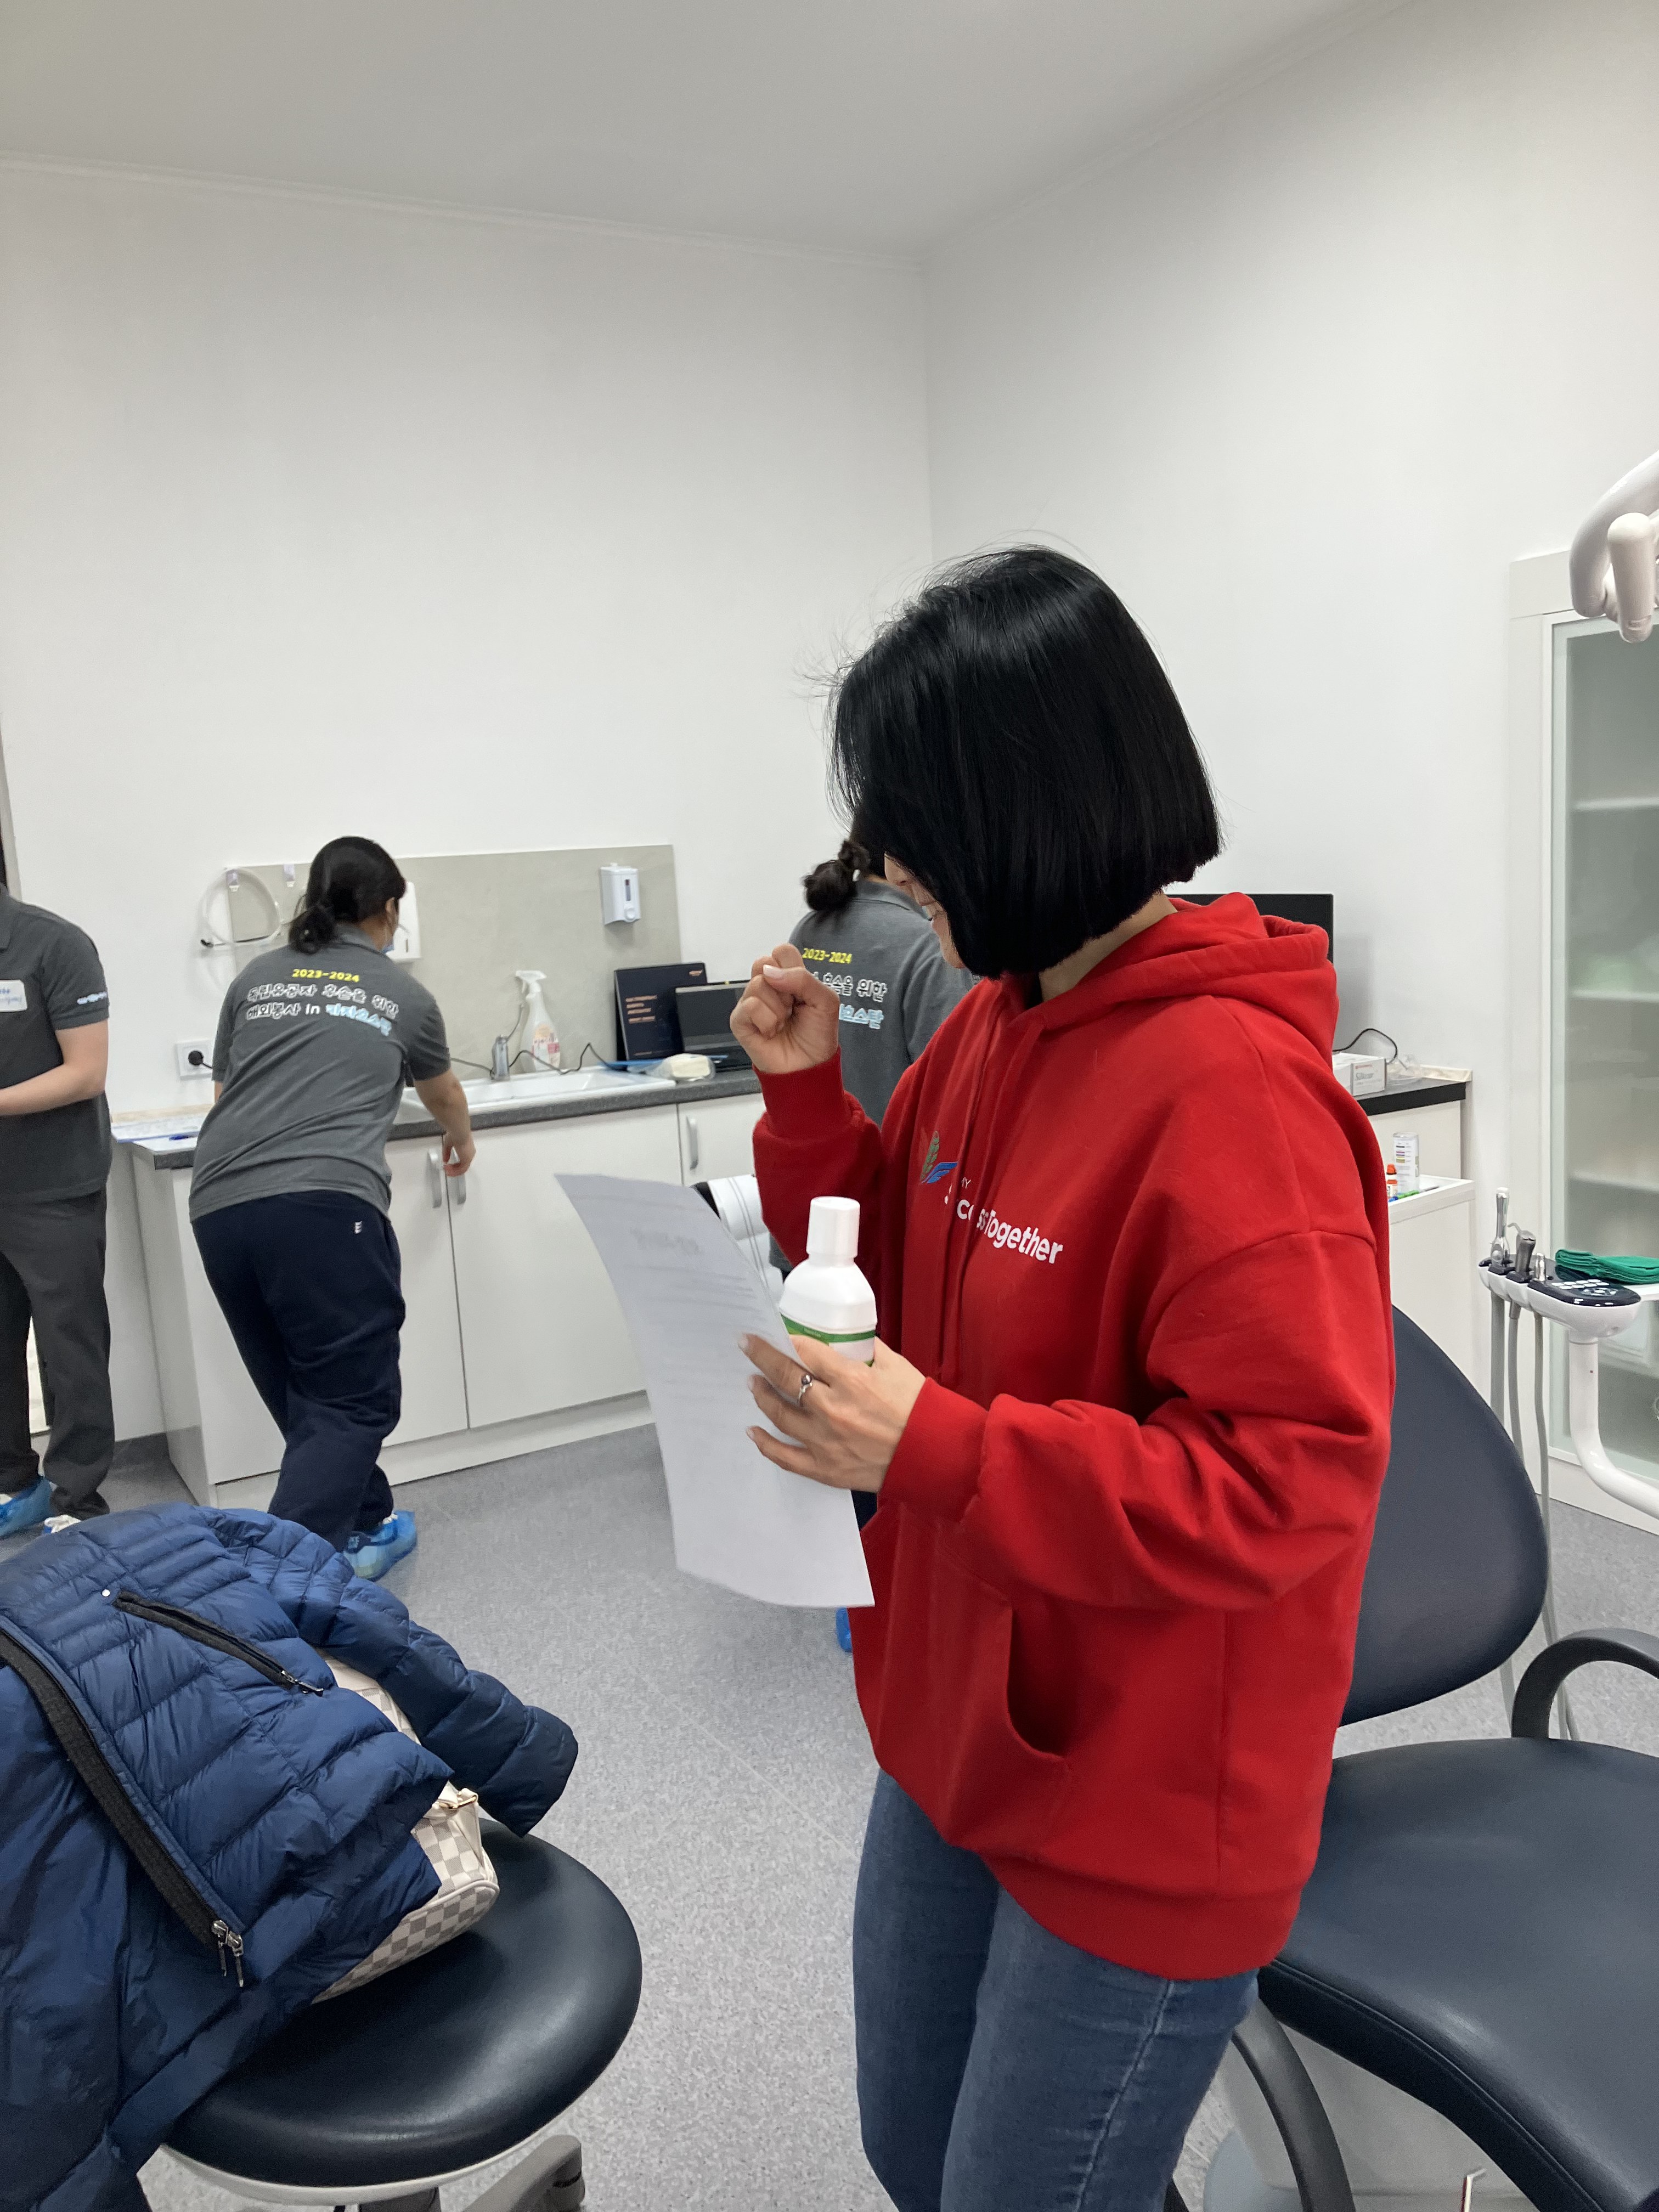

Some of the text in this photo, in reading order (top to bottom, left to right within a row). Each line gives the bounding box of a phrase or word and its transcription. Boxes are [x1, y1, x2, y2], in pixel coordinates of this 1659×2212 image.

[802, 947, 853, 964] 2023-2024
[292, 969, 360, 982] 2023-2024
[856, 979, 888, 1002] 위한
